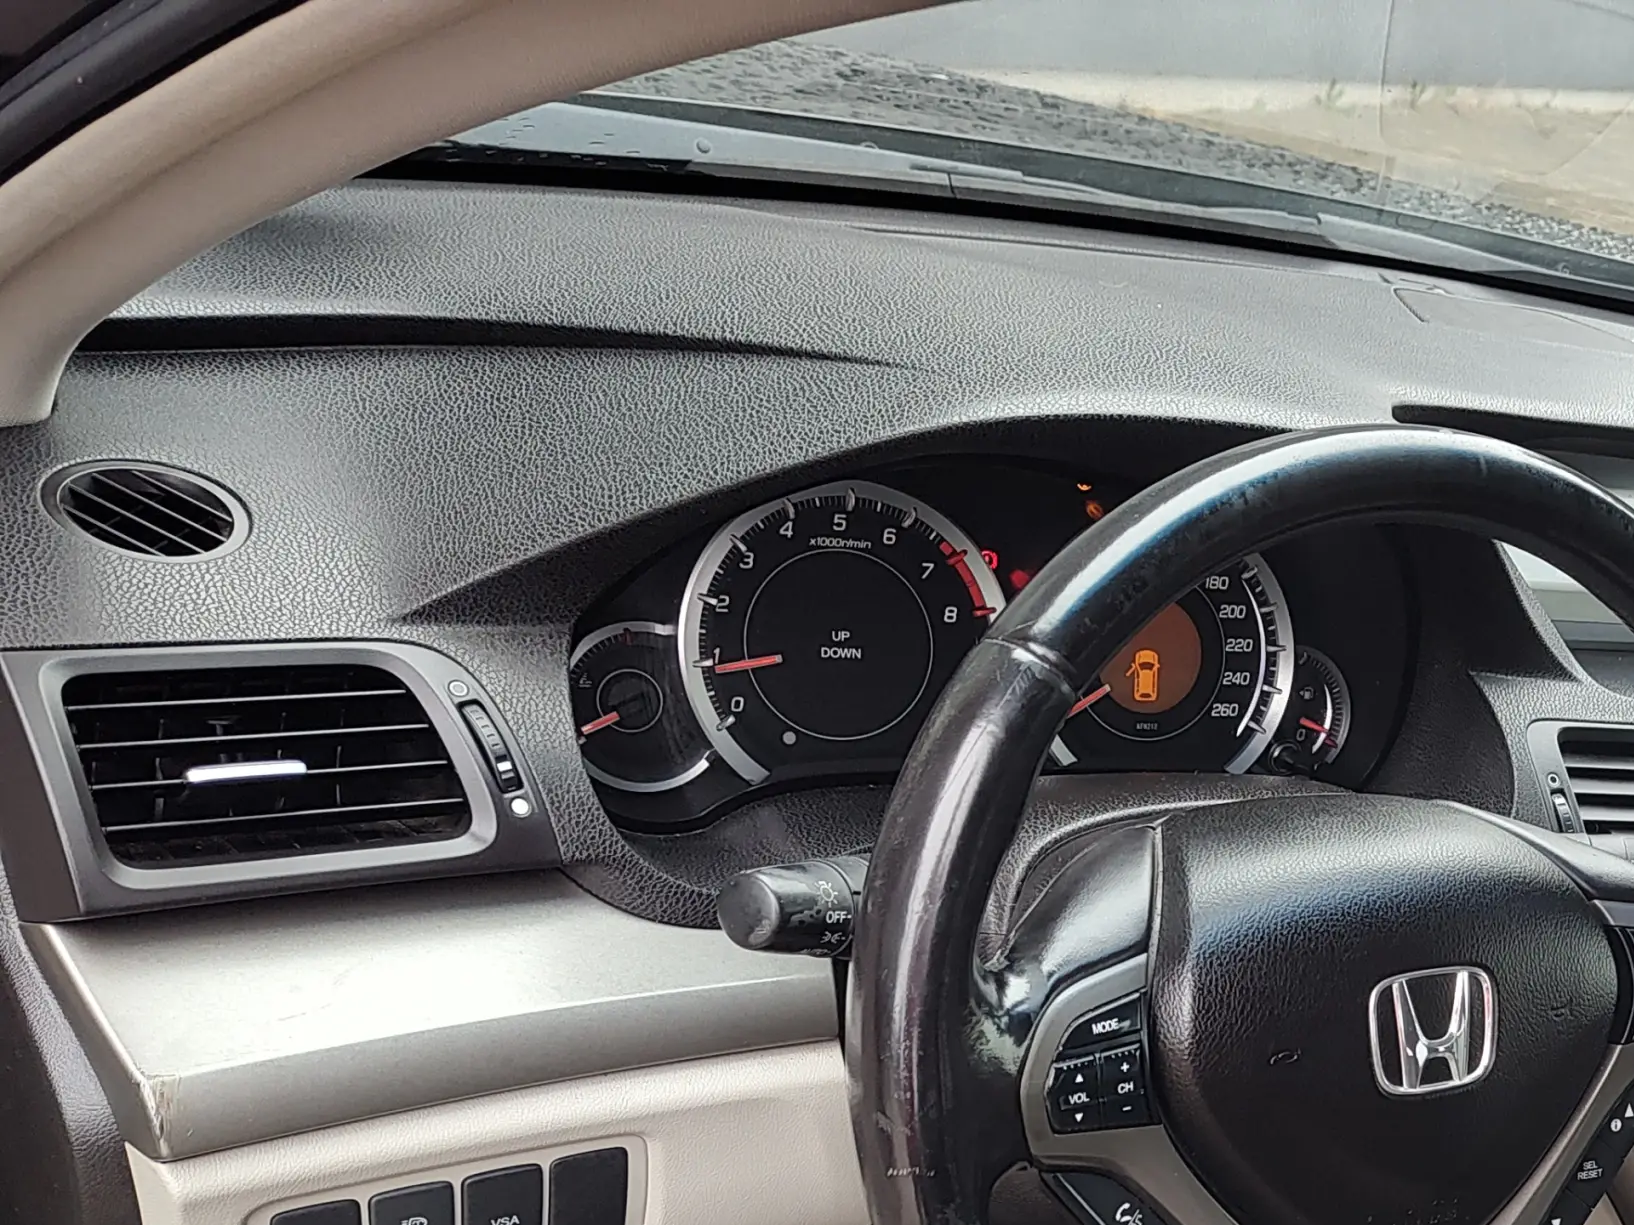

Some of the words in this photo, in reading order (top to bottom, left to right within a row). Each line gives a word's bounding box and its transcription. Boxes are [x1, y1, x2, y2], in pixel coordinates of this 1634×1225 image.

[779, 520, 794, 538] 4
[833, 514, 846, 531] 5
[809, 536, 871, 549] x1000r/min
[883, 528, 896, 545] 6
[739, 552, 754, 569] 3
[921, 562, 934, 579] 7
[1205, 575, 1229, 590] 180
[715, 595, 729, 613] 2
[1219, 604, 1246, 619] 200
[944, 606, 957, 623] 8
[831, 630, 851, 641] UP
[1225, 638, 1253, 652] 220
[713, 647, 720, 663] 1
[820, 647, 862, 659] DOWN
[1222, 672, 1250, 686] 240
[730, 696, 745, 712] 0
[1211, 703, 1239, 717] 260
[826, 911, 848, 924] OFF
[1092, 1018, 1119, 1035] MODE
[1117, 1081, 1134, 1094] CH
[1069, 1092, 1090, 1105] VOL
[1583, 1160, 1598, 1170] SEL
[1577, 1168, 1603, 1180] RESET
